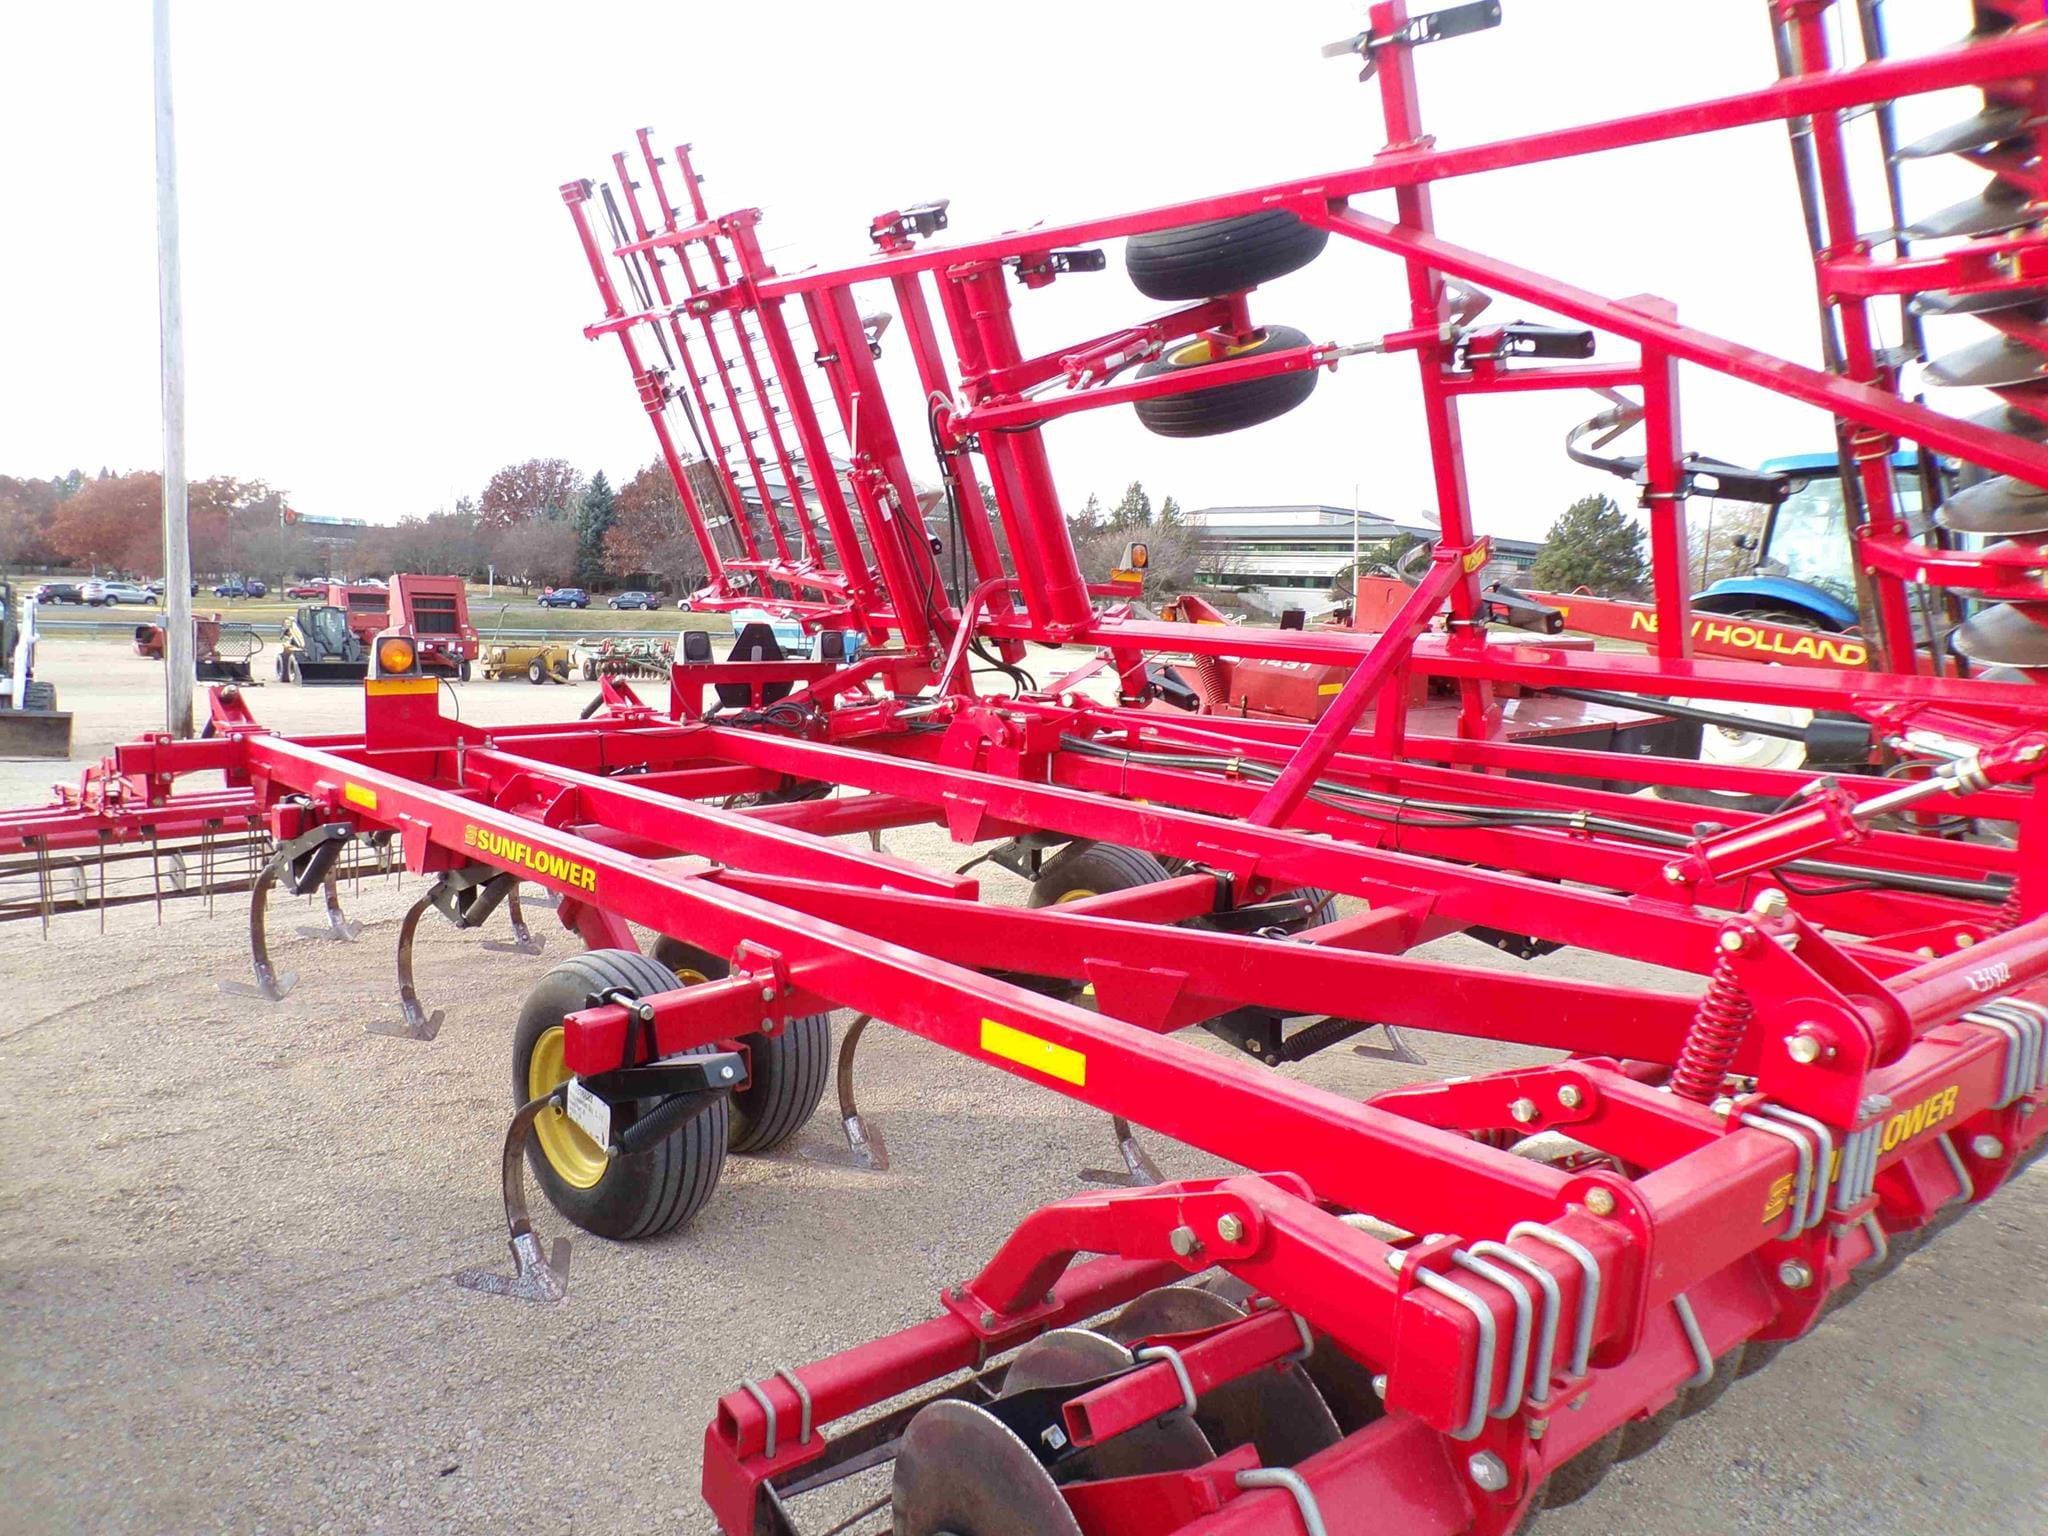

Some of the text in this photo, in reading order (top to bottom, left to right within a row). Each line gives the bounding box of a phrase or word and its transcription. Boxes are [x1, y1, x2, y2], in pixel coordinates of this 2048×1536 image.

[1630, 611, 1868, 666] NE HOLLAND
[477, 829, 597, 893] SUNFLOWER
